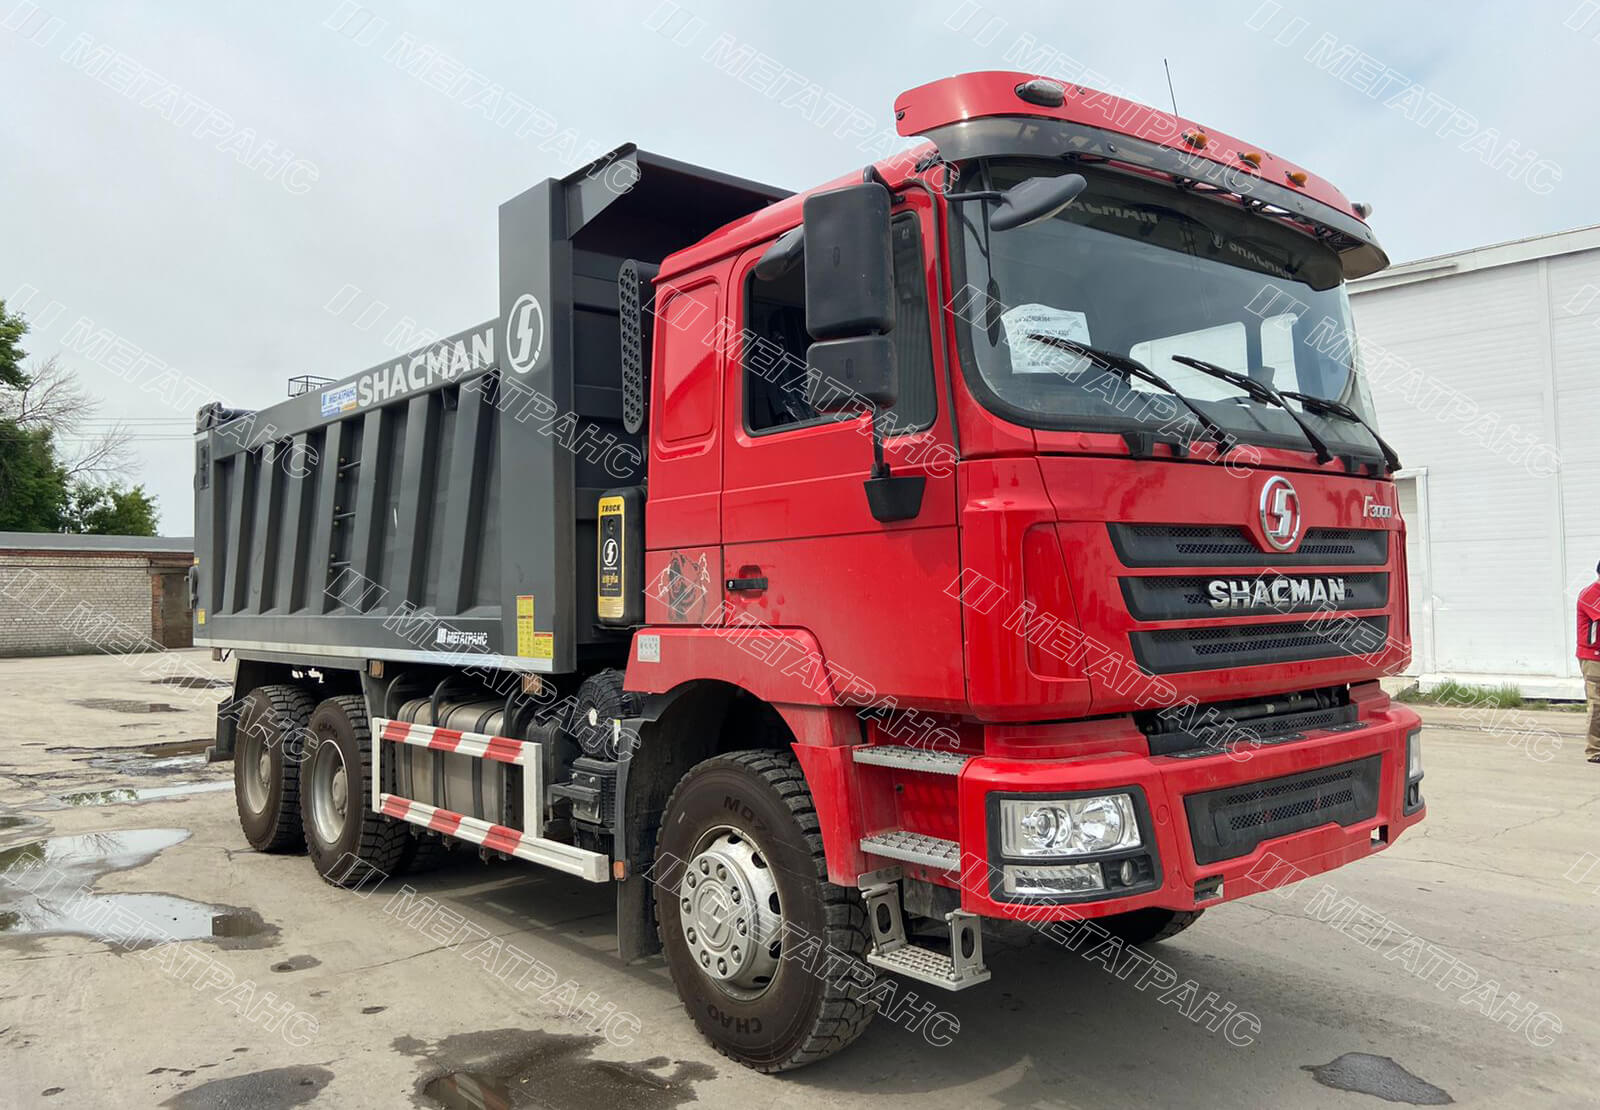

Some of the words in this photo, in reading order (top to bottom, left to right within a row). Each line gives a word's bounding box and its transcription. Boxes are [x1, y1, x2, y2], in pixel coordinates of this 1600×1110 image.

[358, 328, 494, 407] SHACMAN
[602, 504, 620, 512] TRUCK
[1208, 578, 1346, 609] SHACMAN
